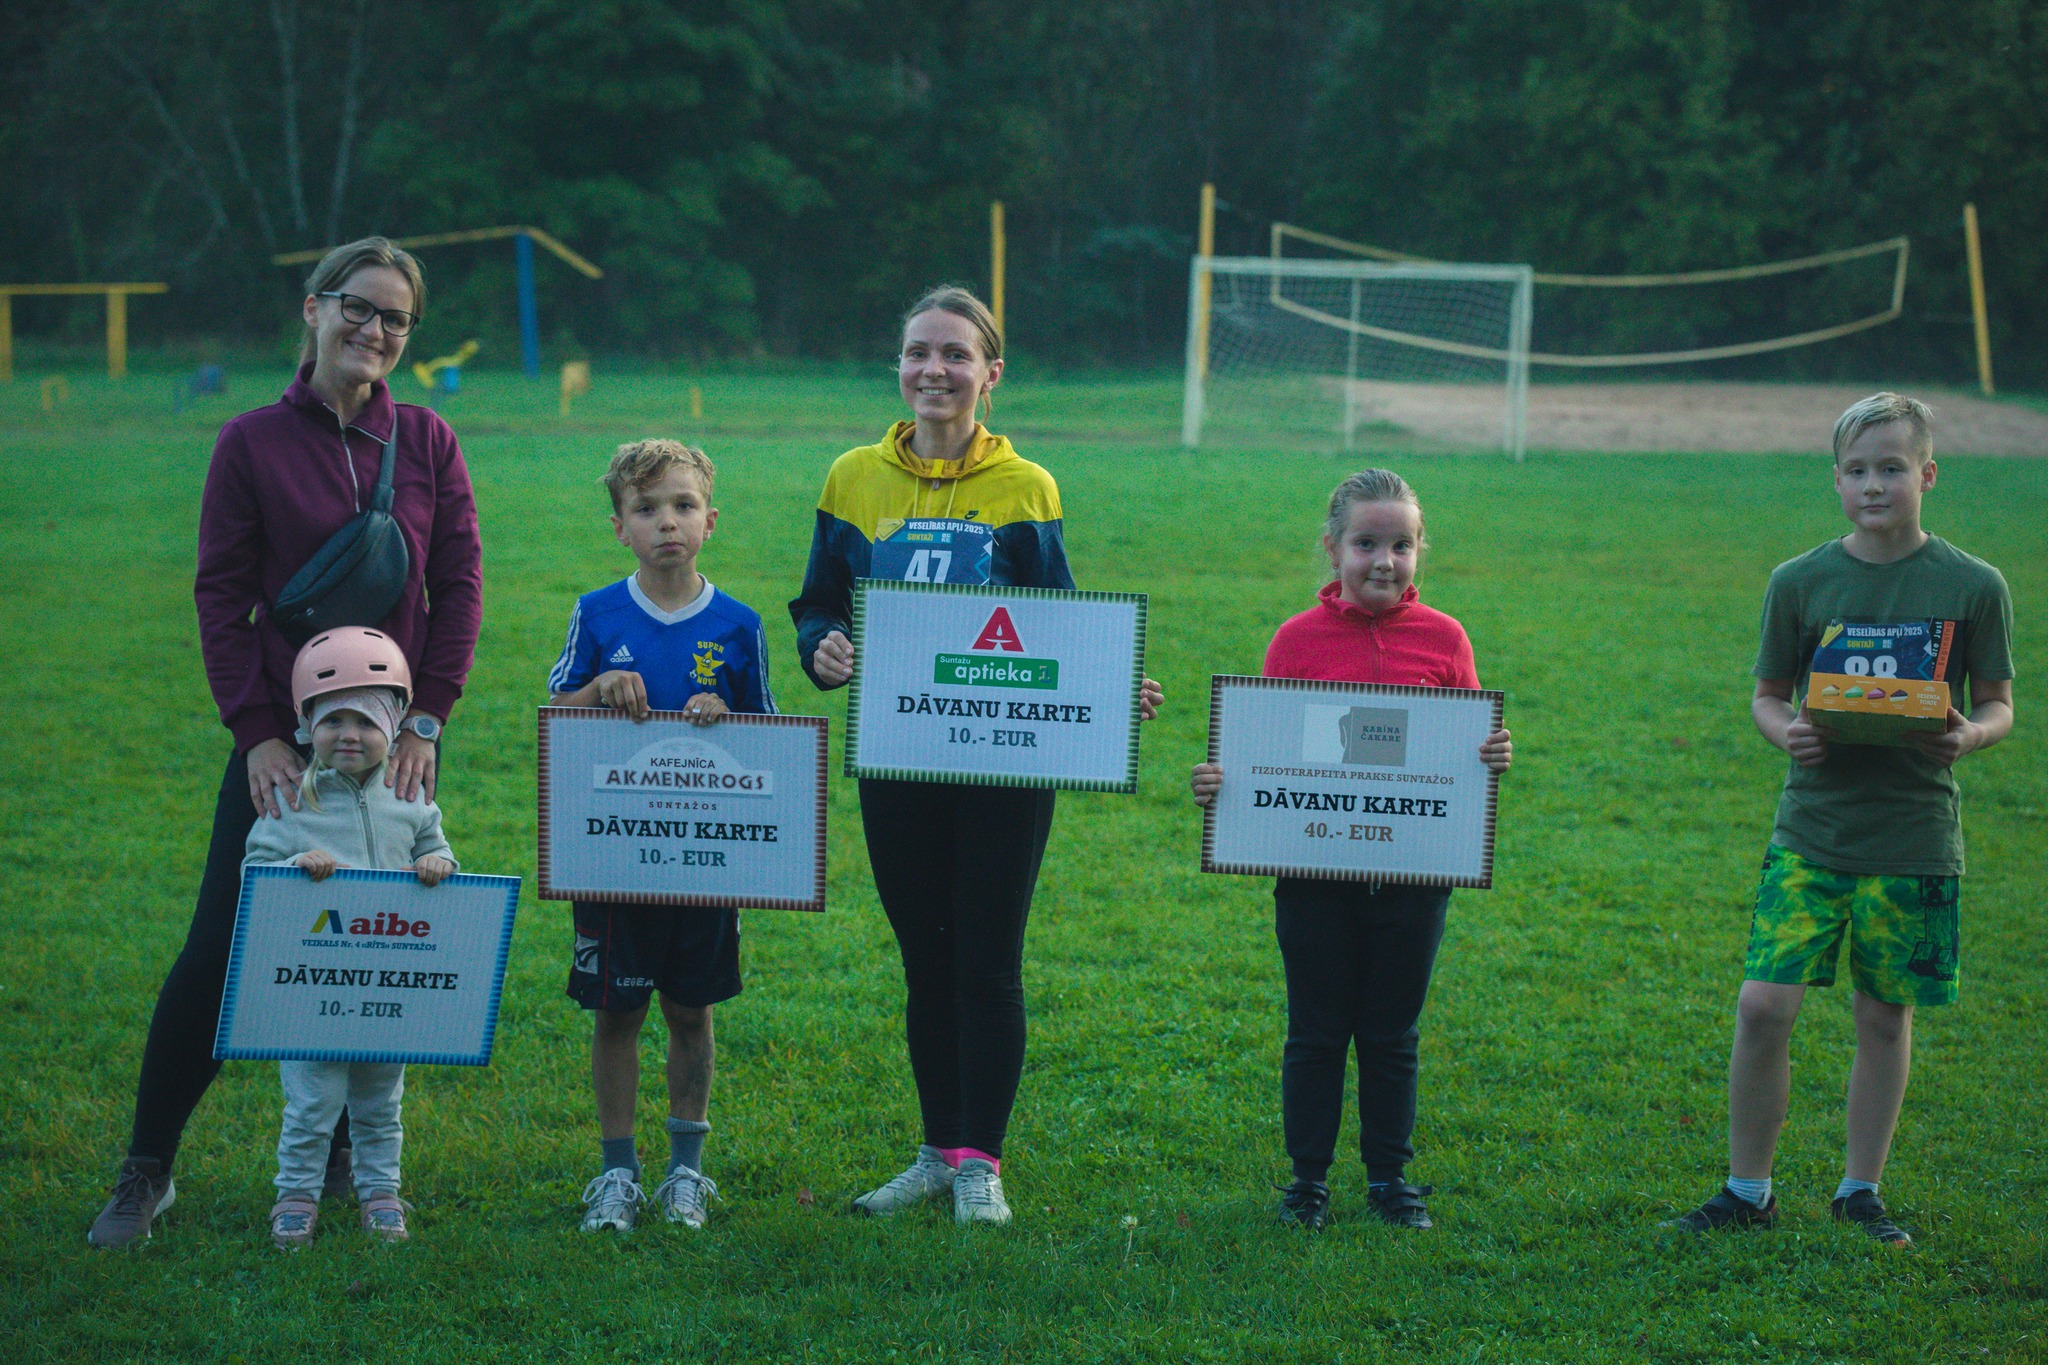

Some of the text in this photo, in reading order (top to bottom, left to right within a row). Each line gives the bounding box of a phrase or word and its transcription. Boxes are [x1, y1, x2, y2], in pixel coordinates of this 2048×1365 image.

[909, 521, 984, 534] VESELĪBAS APĻI 2025
[905, 549, 952, 583] 47
[1847, 626, 1922, 639] VESELĪBAS APĻI 2025
[697, 641, 724, 654] SUPER
[610, 655, 634, 663] adidas
[940, 655, 971, 665] Suntažu
[697, 675, 717, 686] NOVA
[954, 662, 1032, 685] aptieka
[897, 694, 1091, 723] DĀVANU KARTE
[948, 727, 1037, 748] 10.- EUR
[650, 757, 715, 769] KAFEJNĪCA
[606, 770, 765, 790] AKMEŅKROGS
[1252, 765, 1455, 785] FIZIOTERAPEITA PRAKSE SUNTAŽOS
[649, 800, 718, 810] SUNTAŽOS
[1254, 787, 1447, 818] DĀVANU KARTE
[586, 815, 778, 842] DĀVANU KARTE
[1304, 822, 1394, 842] 40.- EUR
[639, 848, 726, 867] 10.- EUR
[349, 912, 431, 938] aibe
[302, 939, 339, 947] VEIKALS
[340, 940, 353, 948] Nr.
[392, 942, 437, 951] SUNTAŽOS
[274, 965, 458, 990] DĀVANU KARTE
[616, 977, 654, 987] LEGEA
[319, 1000, 403, 1018] 10.- EUR
